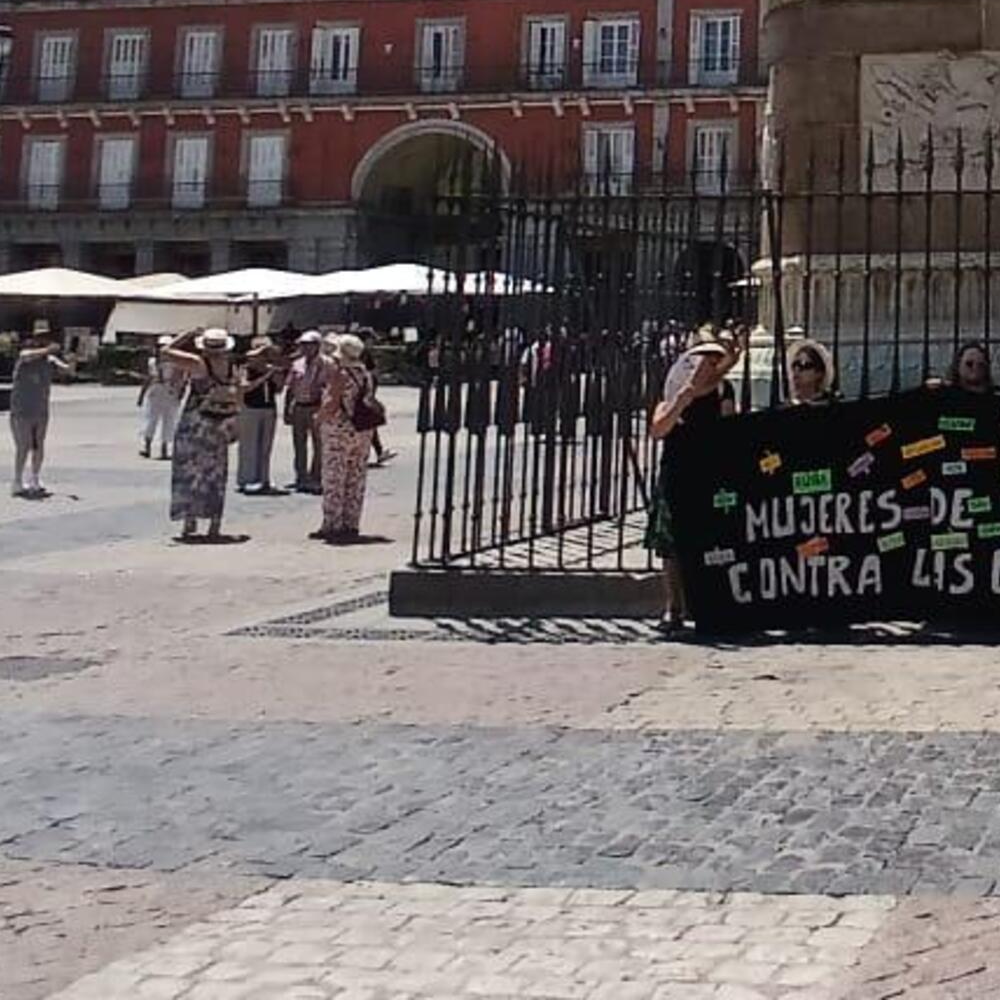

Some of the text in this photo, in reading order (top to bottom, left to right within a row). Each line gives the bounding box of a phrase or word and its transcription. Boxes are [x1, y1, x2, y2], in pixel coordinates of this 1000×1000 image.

[745, 488, 902, 543] MUJERES
[929, 487, 974, 529] DE
[727, 553, 883, 604] CONTRA
